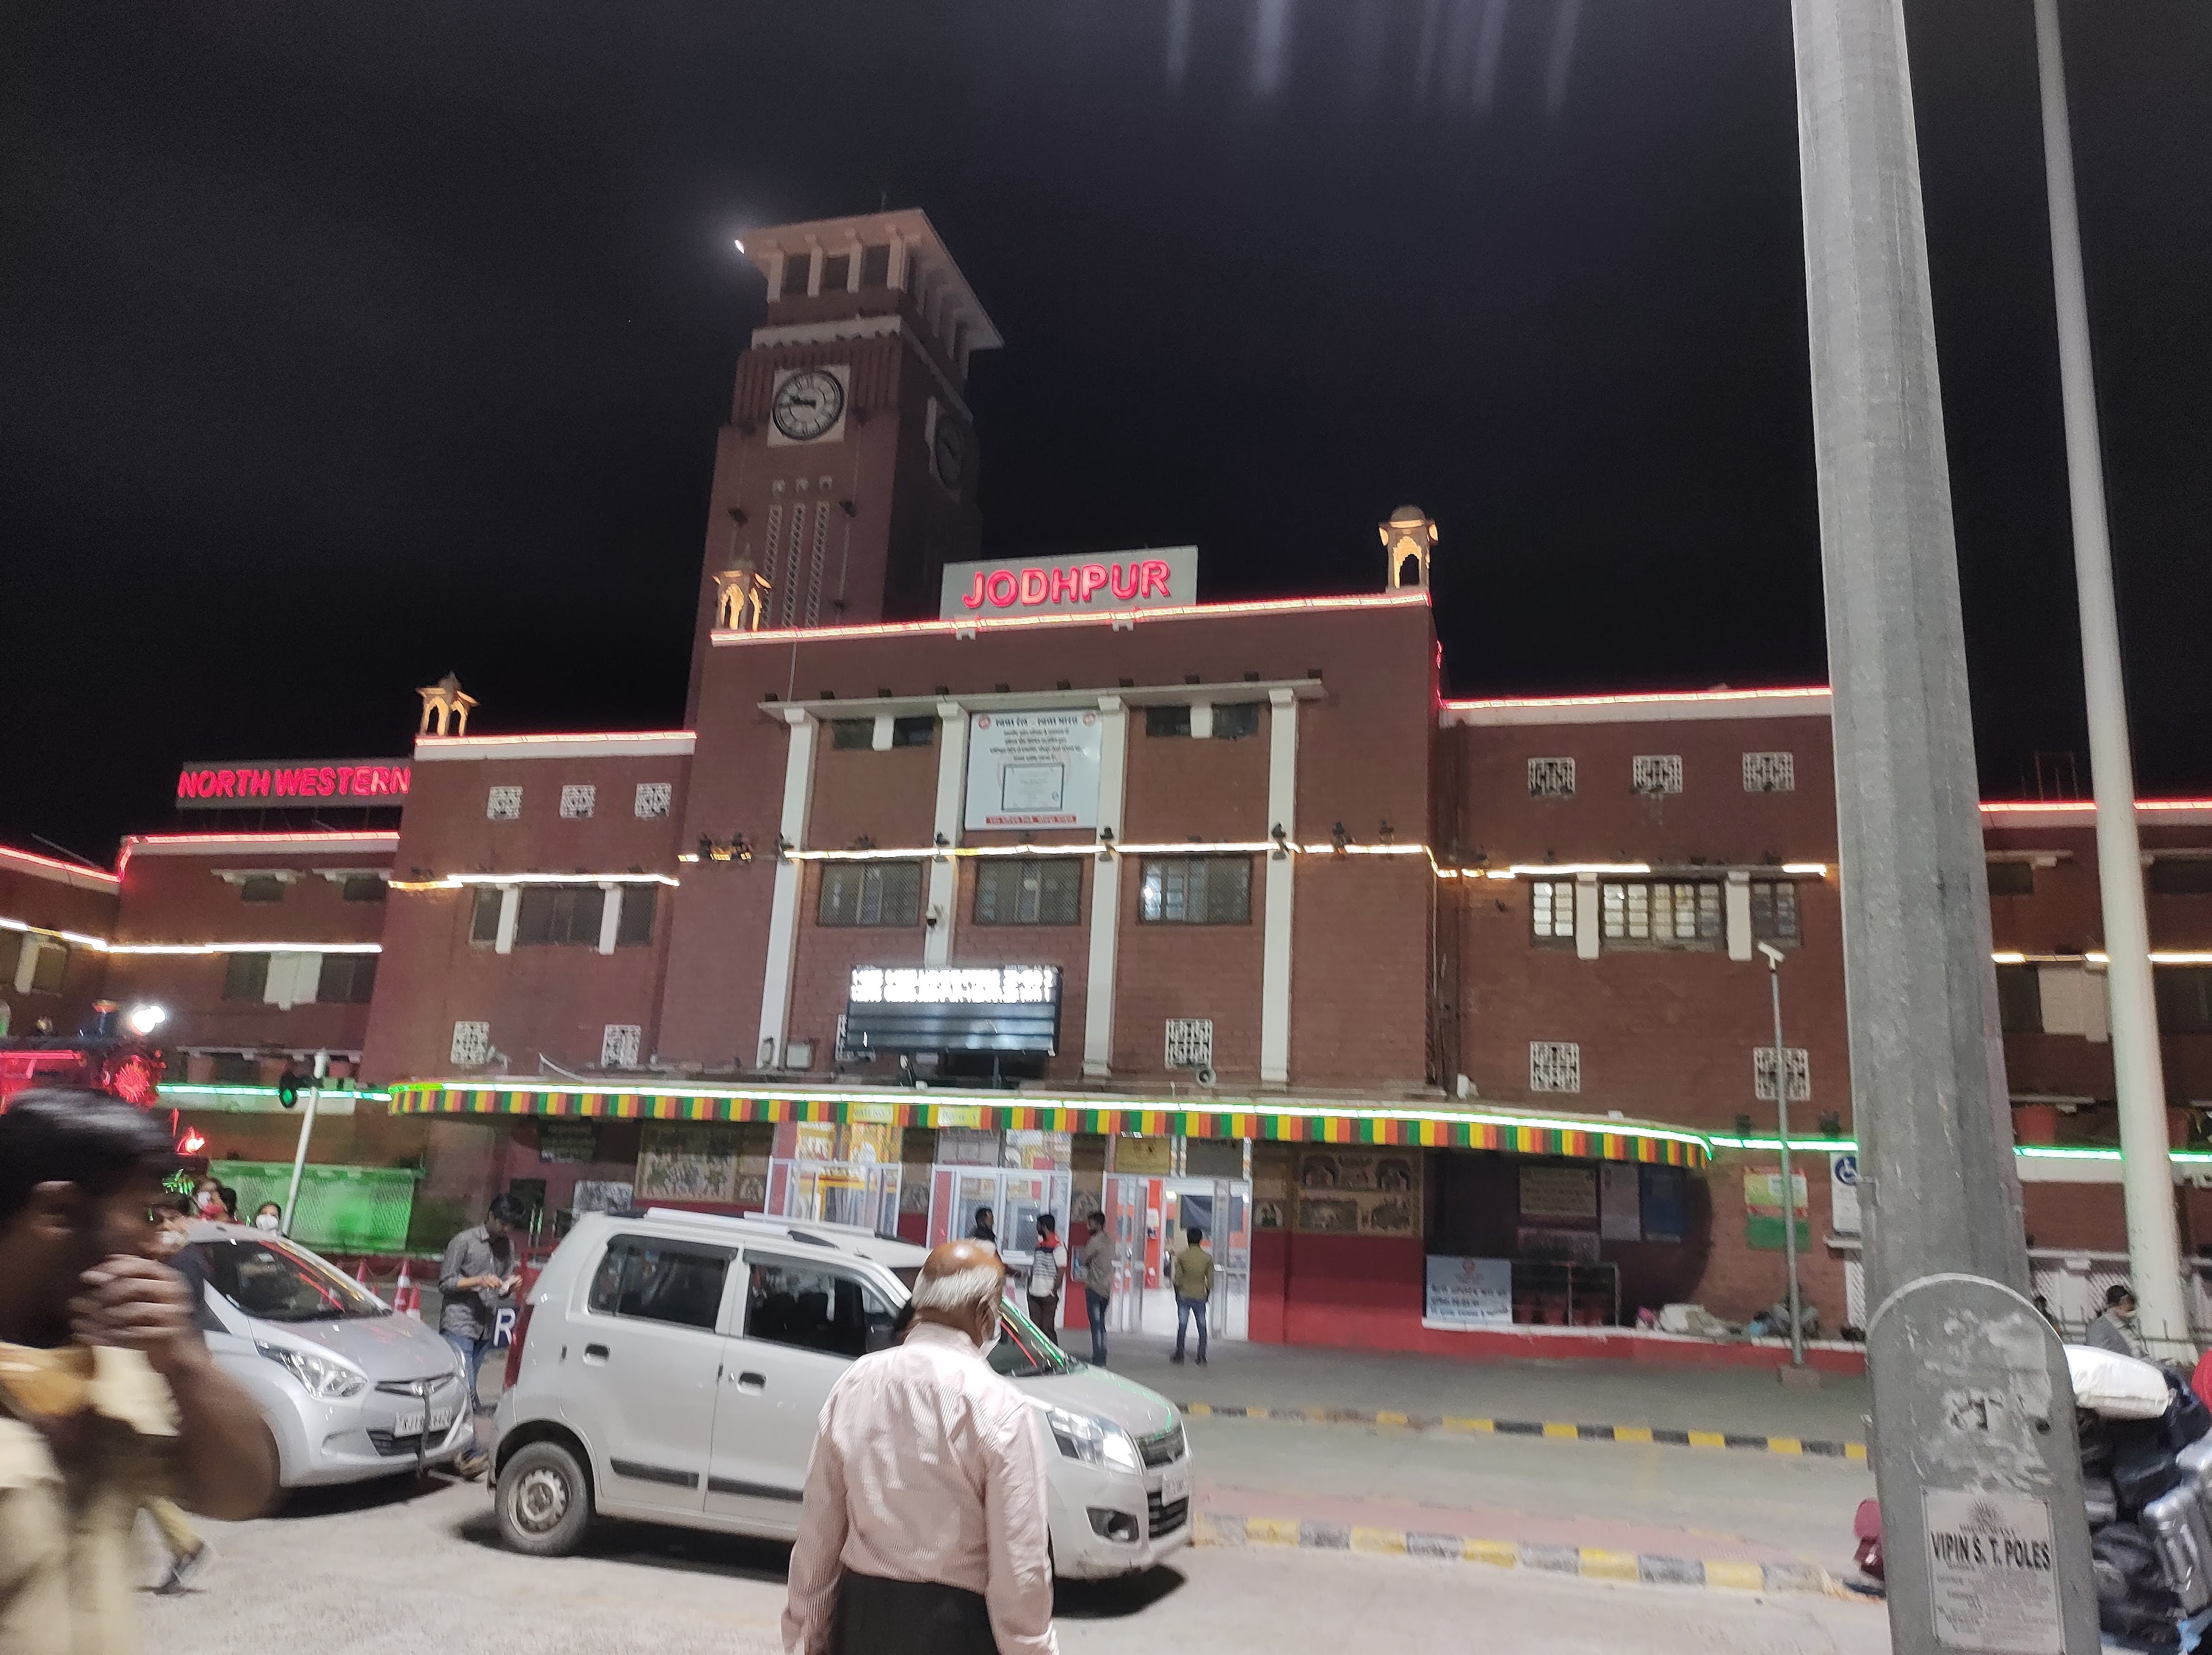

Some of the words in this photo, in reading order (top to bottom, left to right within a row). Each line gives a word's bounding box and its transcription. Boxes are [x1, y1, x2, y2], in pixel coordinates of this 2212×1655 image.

[962, 560, 1170, 609] JODHPUR
[177, 769, 270, 798] NORTH
[275, 766, 411, 797] WESTERN
[1931, 1530, 1969, 1563] VIPIN
[2005, 1538, 2051, 1572] POLES
